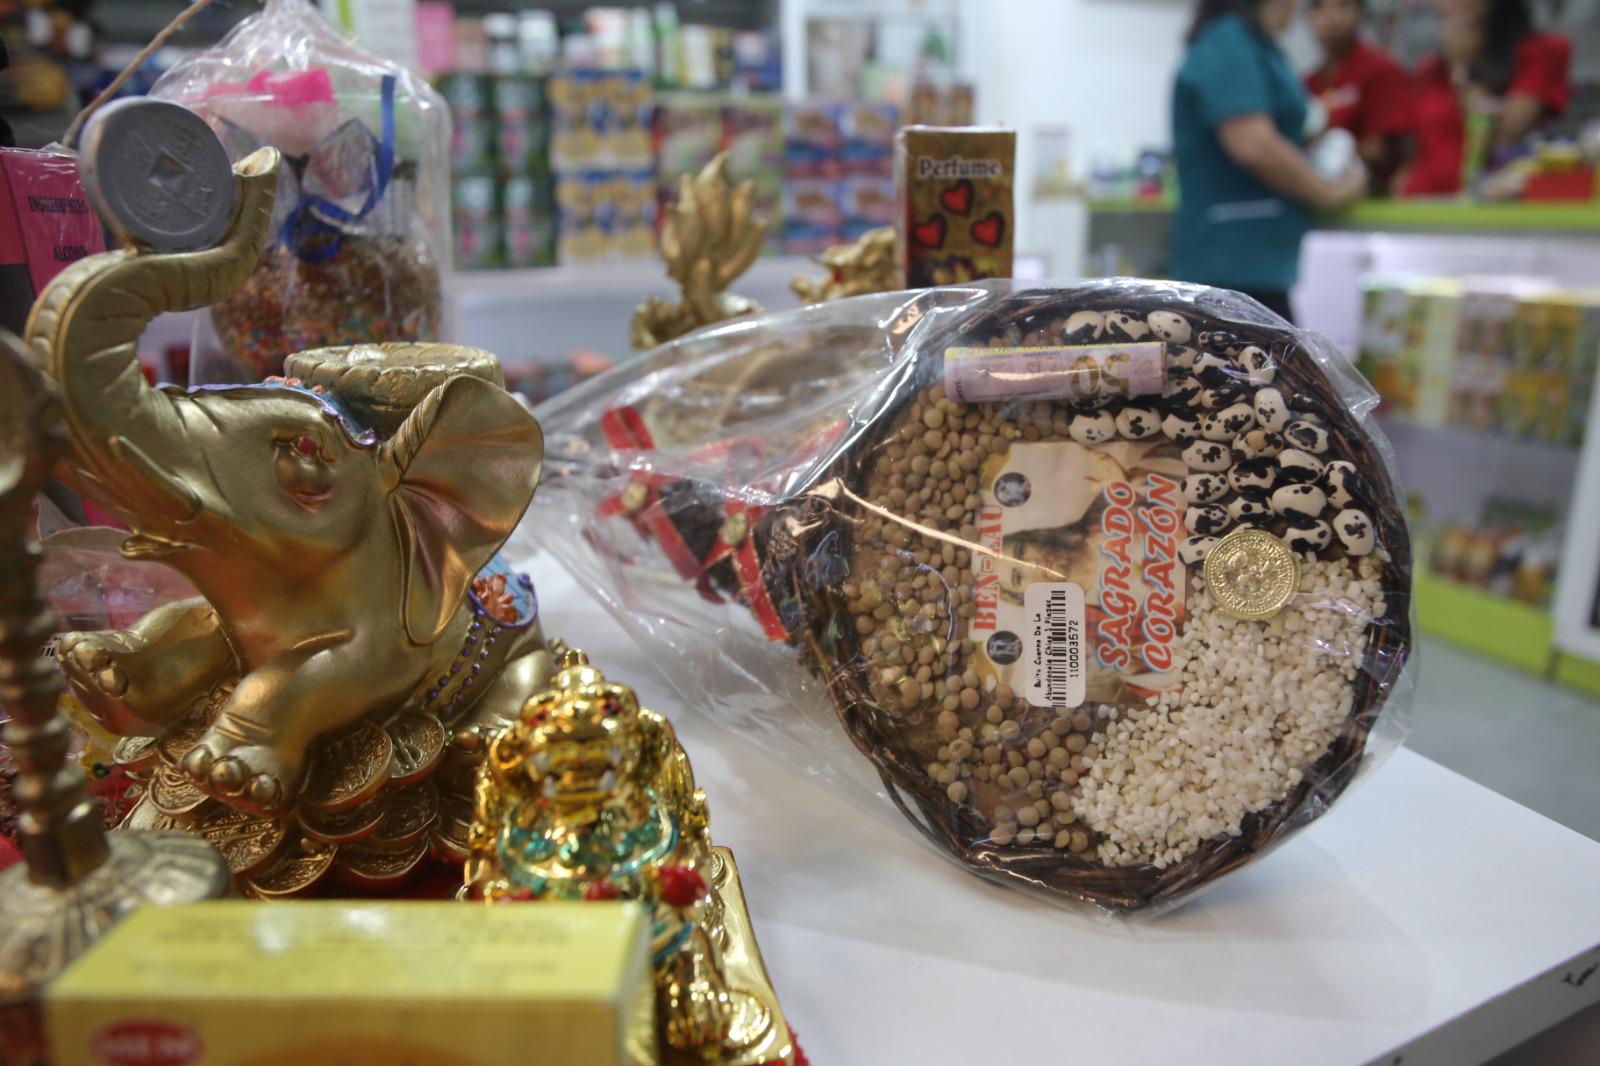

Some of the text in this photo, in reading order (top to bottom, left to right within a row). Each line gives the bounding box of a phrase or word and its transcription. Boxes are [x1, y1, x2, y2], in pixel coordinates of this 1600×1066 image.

[919, 157, 1000, 177] Perfume
[1100, 480, 1137, 669] SAGRADO
[1139, 474, 1179, 671] CORAZÓN
[1034, 613, 1041, 622] La
[1034, 626, 1041, 636] De
